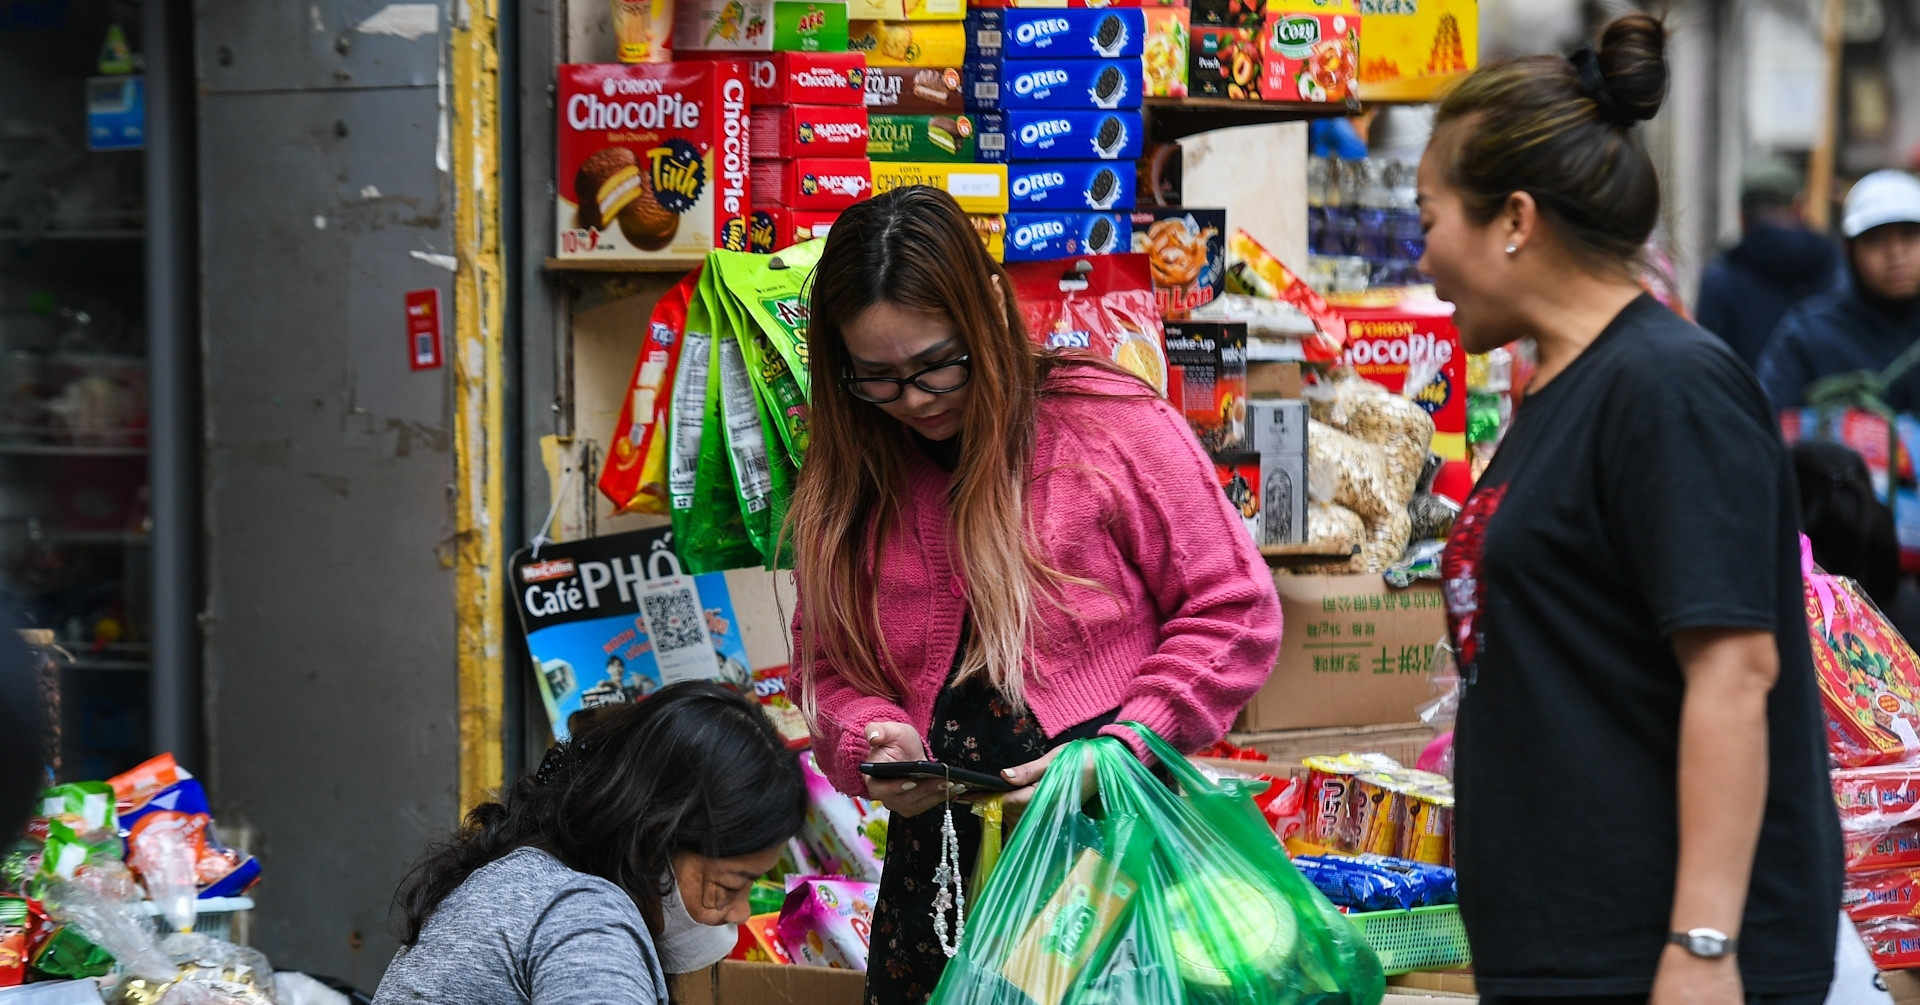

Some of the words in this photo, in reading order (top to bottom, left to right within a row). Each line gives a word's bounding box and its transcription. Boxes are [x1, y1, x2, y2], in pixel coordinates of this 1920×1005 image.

[1016, 18, 1070, 43] OREO
[1278, 21, 1316, 42] Cozy
[617, 79, 663, 95] ORION
[798, 72, 848, 88] ChocoPie
[1015, 69, 1068, 95] OREO
[567, 92, 700, 131] ChocoPie
[814, 123, 862, 137] ChocoPie
[1020, 120, 1071, 144] OREO
[723, 78, 745, 213] ChocoPie
[1012, 172, 1065, 196] OREO
[1014, 221, 1064, 247] OREO
[1364, 321, 1414, 337] ORION
[1166, 336, 1216, 354] wake-up
[525, 577, 584, 617] Café
[753, 675, 786, 697] OSY
